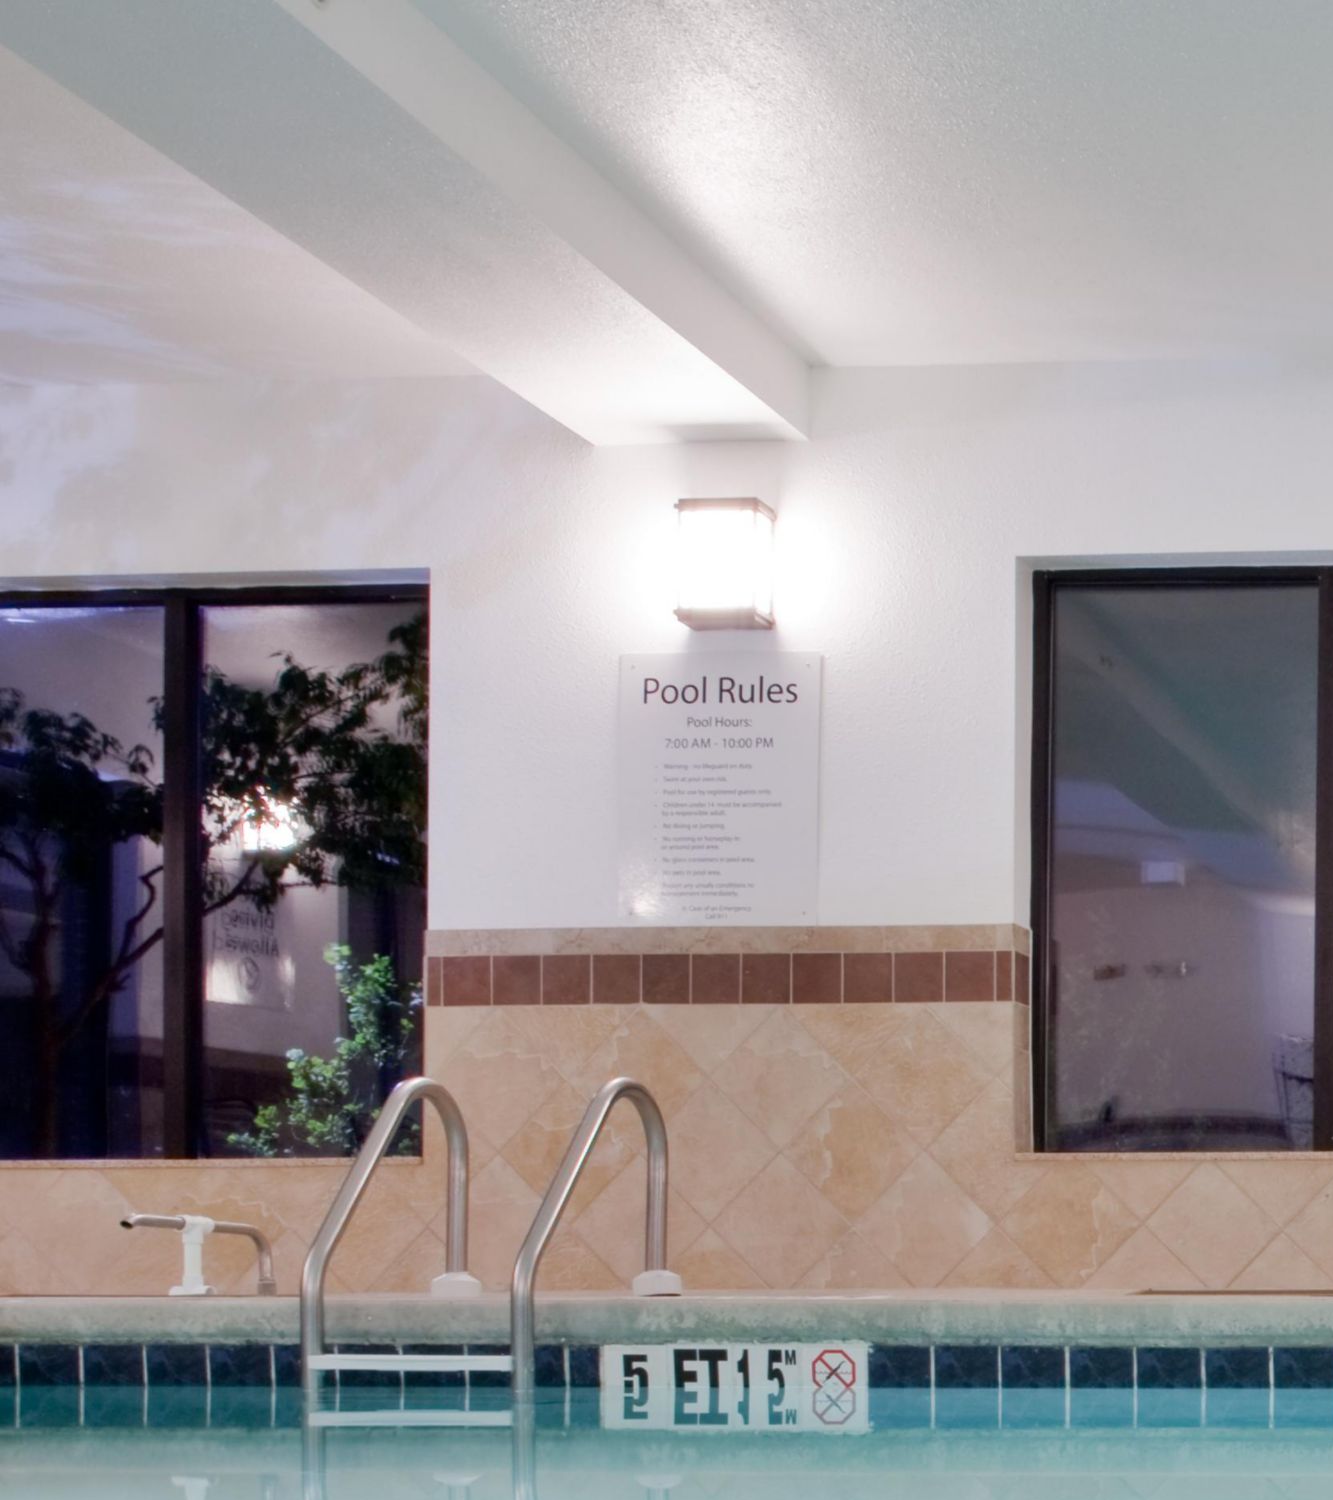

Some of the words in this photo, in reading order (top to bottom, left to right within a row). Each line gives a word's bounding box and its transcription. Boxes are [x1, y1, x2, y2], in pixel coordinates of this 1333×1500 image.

[643, 676, 707, 704] Pool
[718, 676, 798, 703] Rules
[687, 716, 712, 727] Pool
[715, 716, 753, 727] Hours:
[665, 738, 689, 749] 7:00
[691, 738, 711, 749] AM
[722, 737, 752, 748] 10:00
[755, 737, 774, 748] PM
